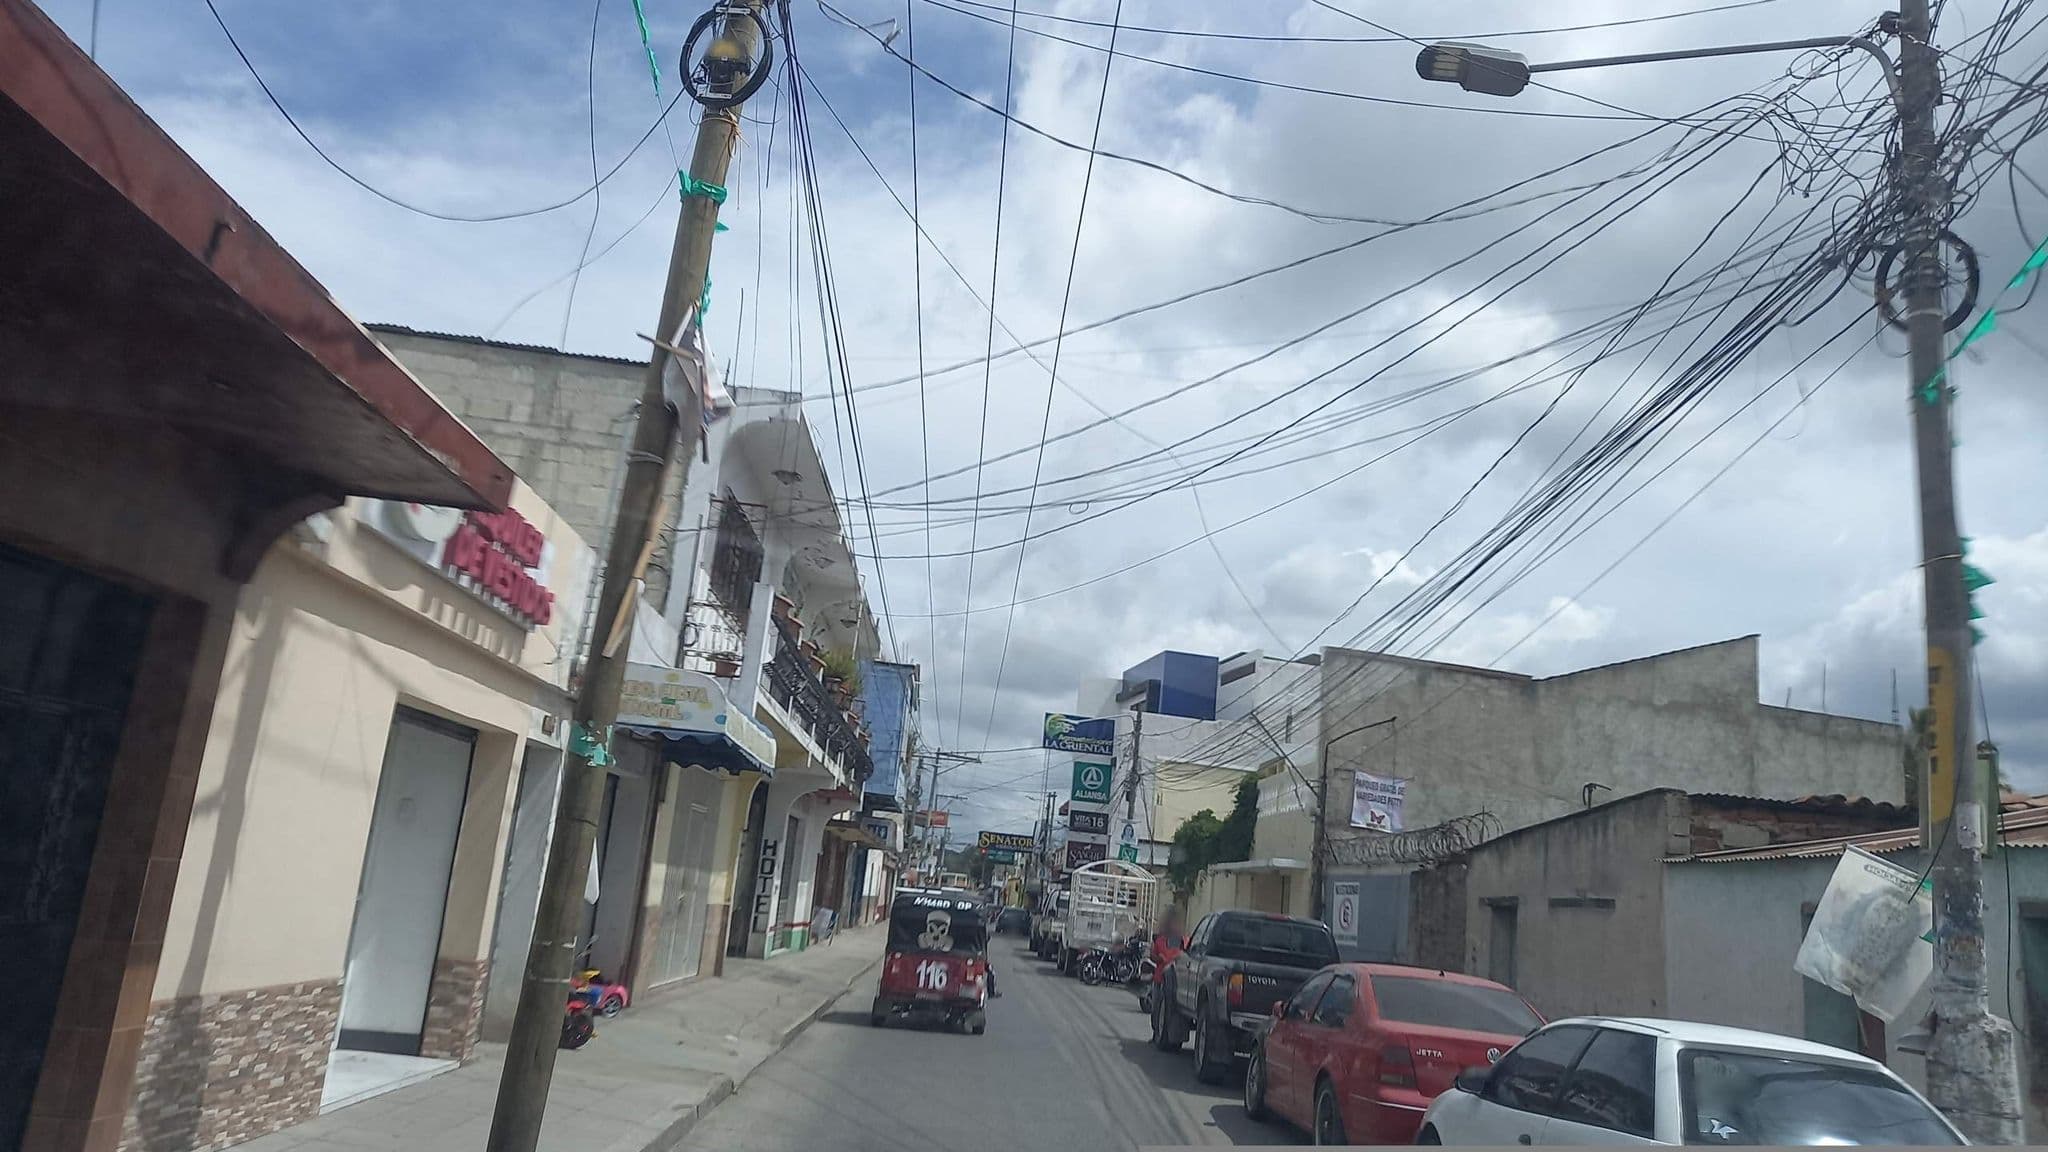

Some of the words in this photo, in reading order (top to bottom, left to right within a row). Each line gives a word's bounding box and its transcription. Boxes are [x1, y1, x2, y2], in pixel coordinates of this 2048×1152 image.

[1045, 739, 1058, 748] LA
[1060, 741, 1112, 754] ORIENTAL
[979, 832, 1033, 848] SENATOR
[752, 839, 777, 933] HOTEL
[916, 959, 948, 992] 116
[1248, 975, 1277, 986] TOYOTA
[1416, 1048, 1443, 1058] JETTA
